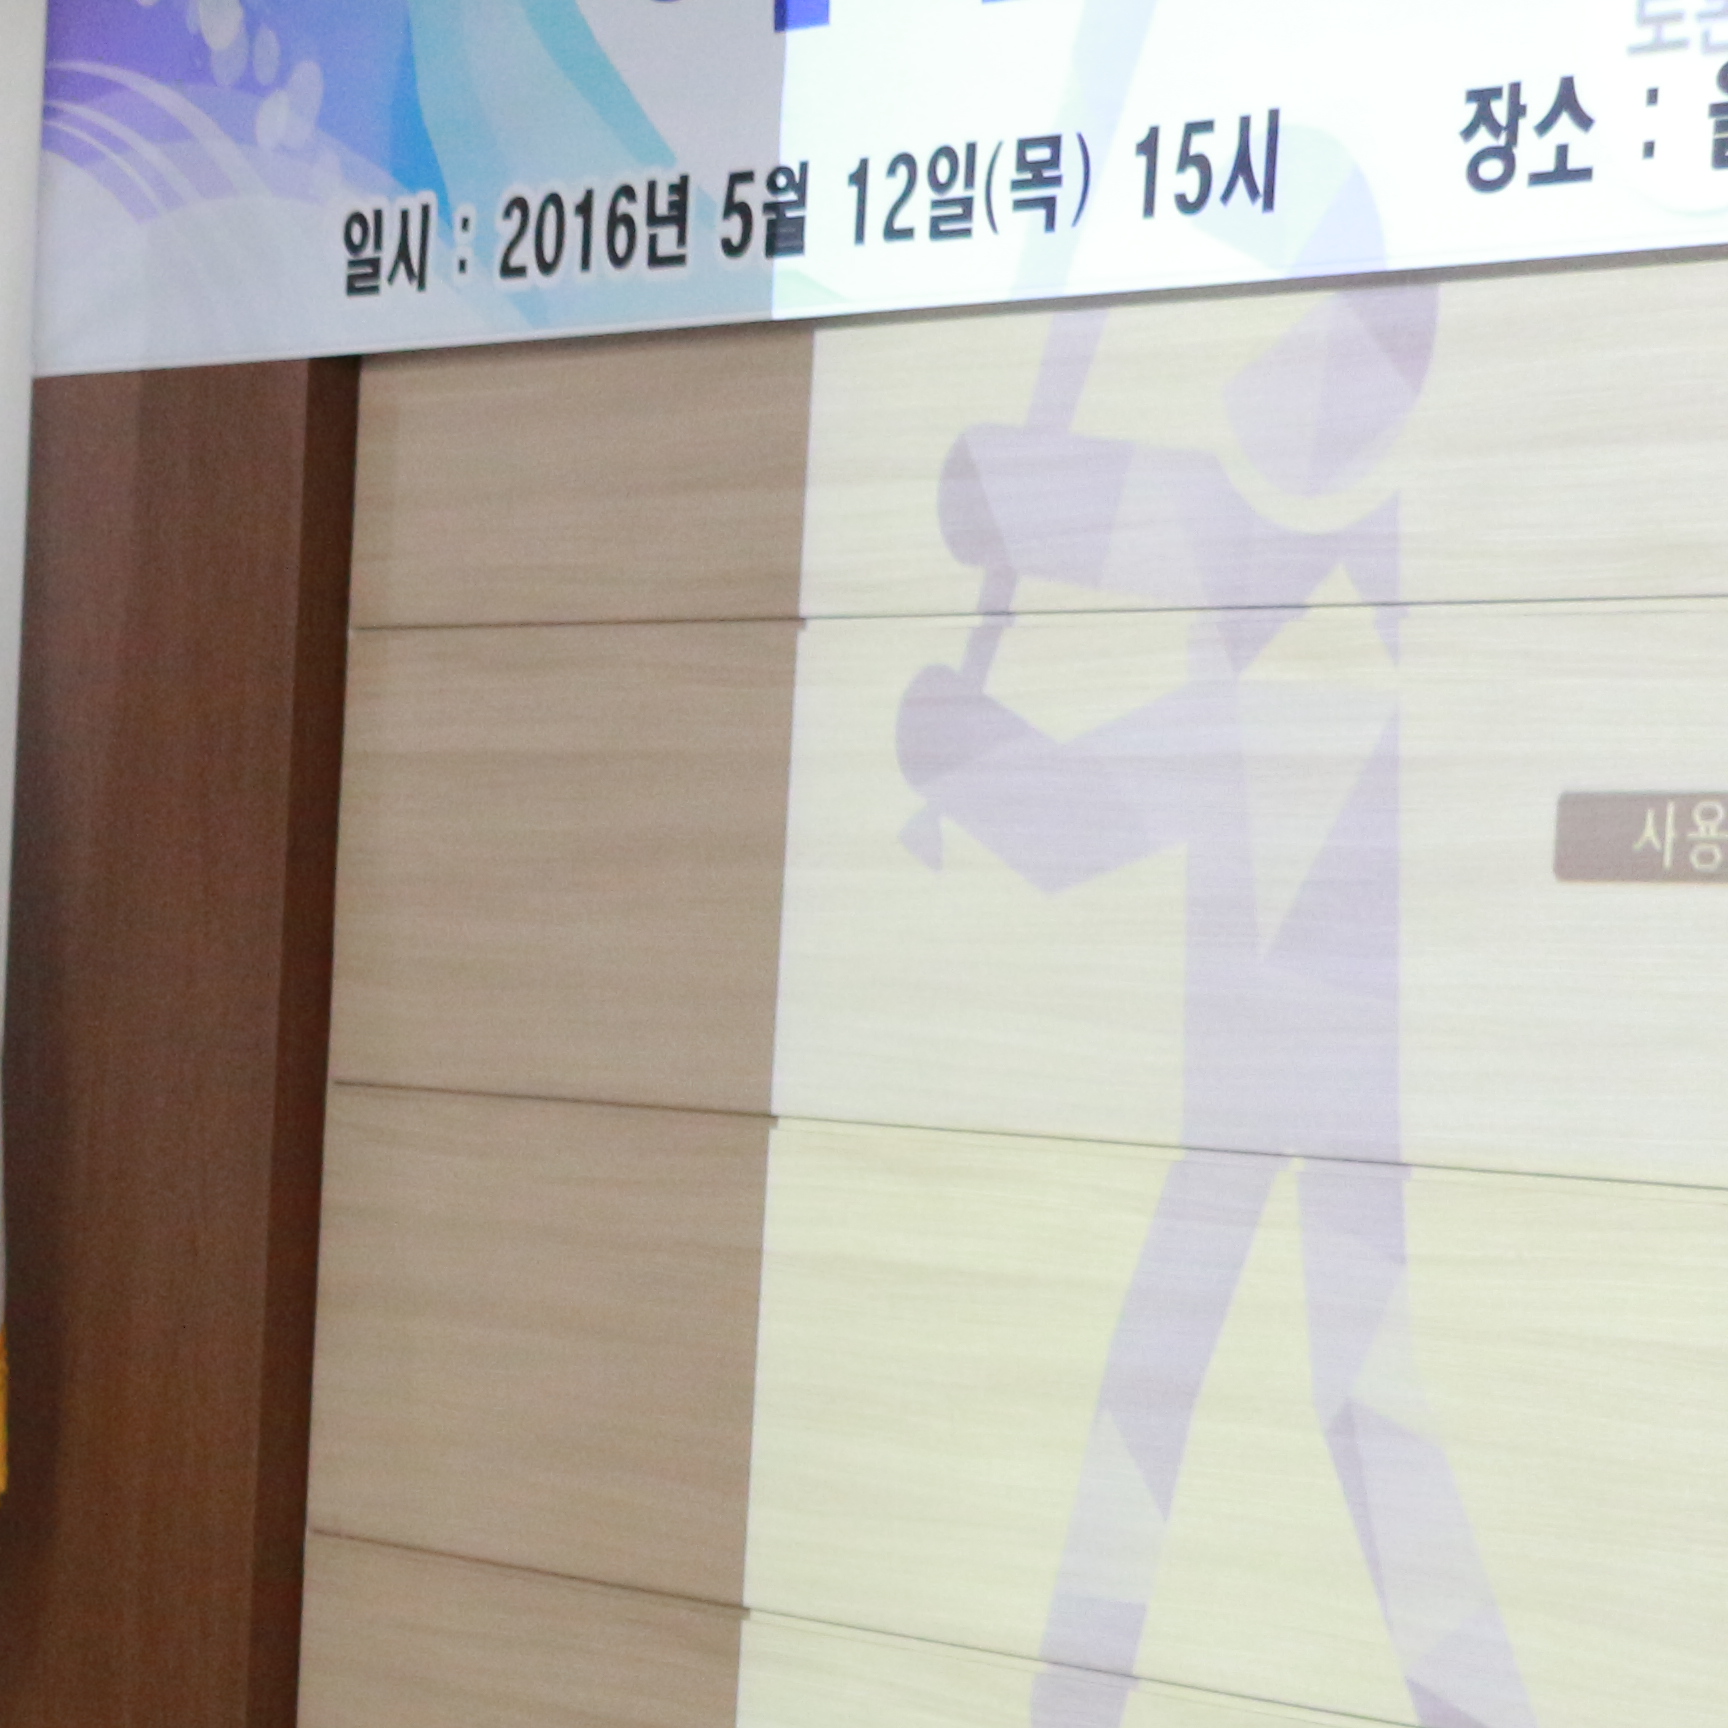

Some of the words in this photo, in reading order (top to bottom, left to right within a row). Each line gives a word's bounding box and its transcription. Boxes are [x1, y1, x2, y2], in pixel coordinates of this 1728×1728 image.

[343, 202, 432, 297] 일시
[499, 174, 690, 280] 2016년
[720, 160, 810, 258] 5월
[847, 131, 1091, 246] 12일(목)
[1135, 107, 1280, 219] 15시
[1459, 75, 1595, 193] 장소
